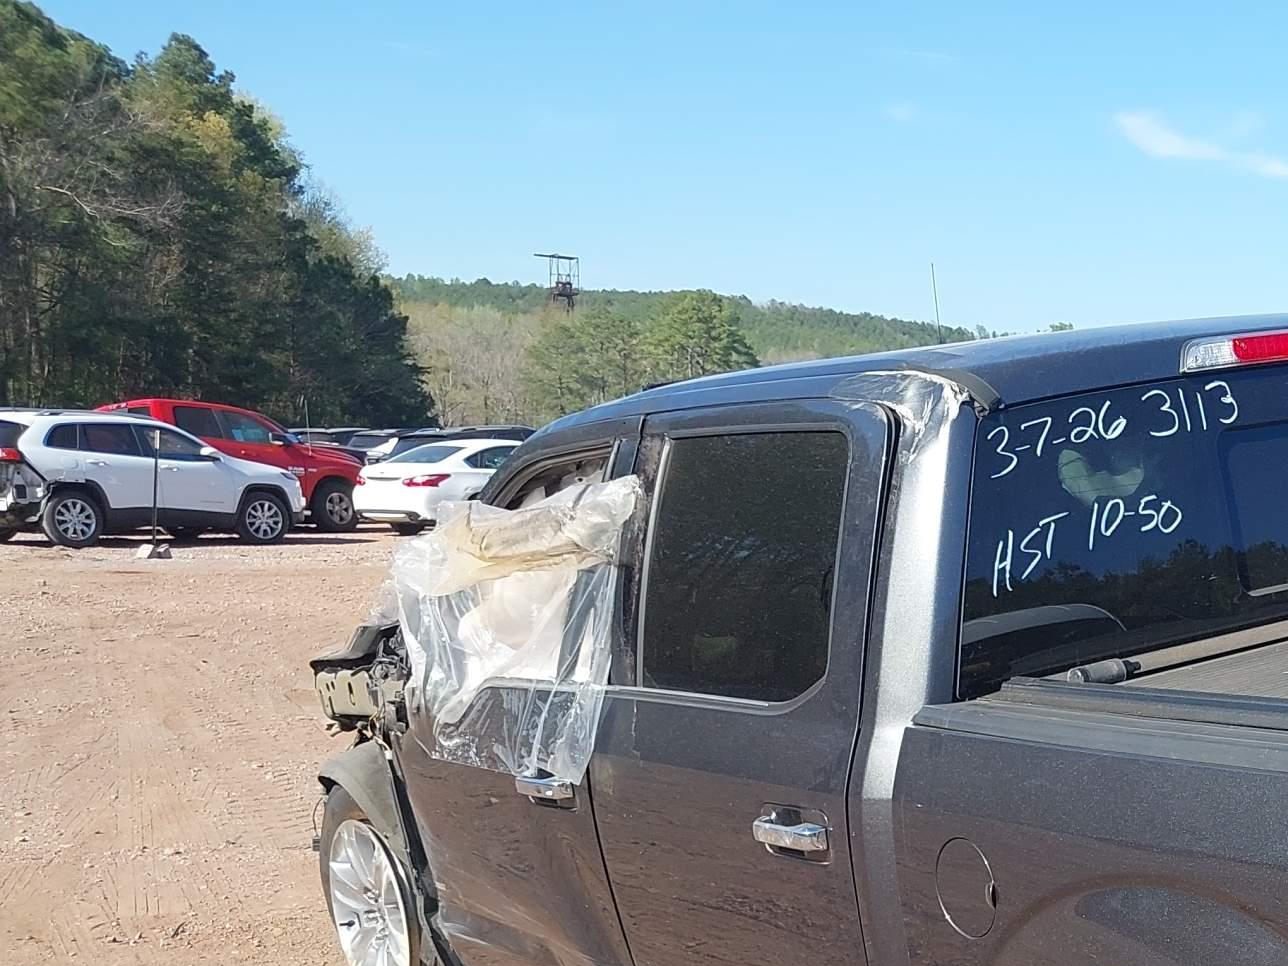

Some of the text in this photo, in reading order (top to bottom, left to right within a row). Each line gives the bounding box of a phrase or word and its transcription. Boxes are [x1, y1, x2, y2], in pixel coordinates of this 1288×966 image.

[987, 380, 1238, 479] 3-7-26 3113
[1088, 495, 1182, 551] 10-50
